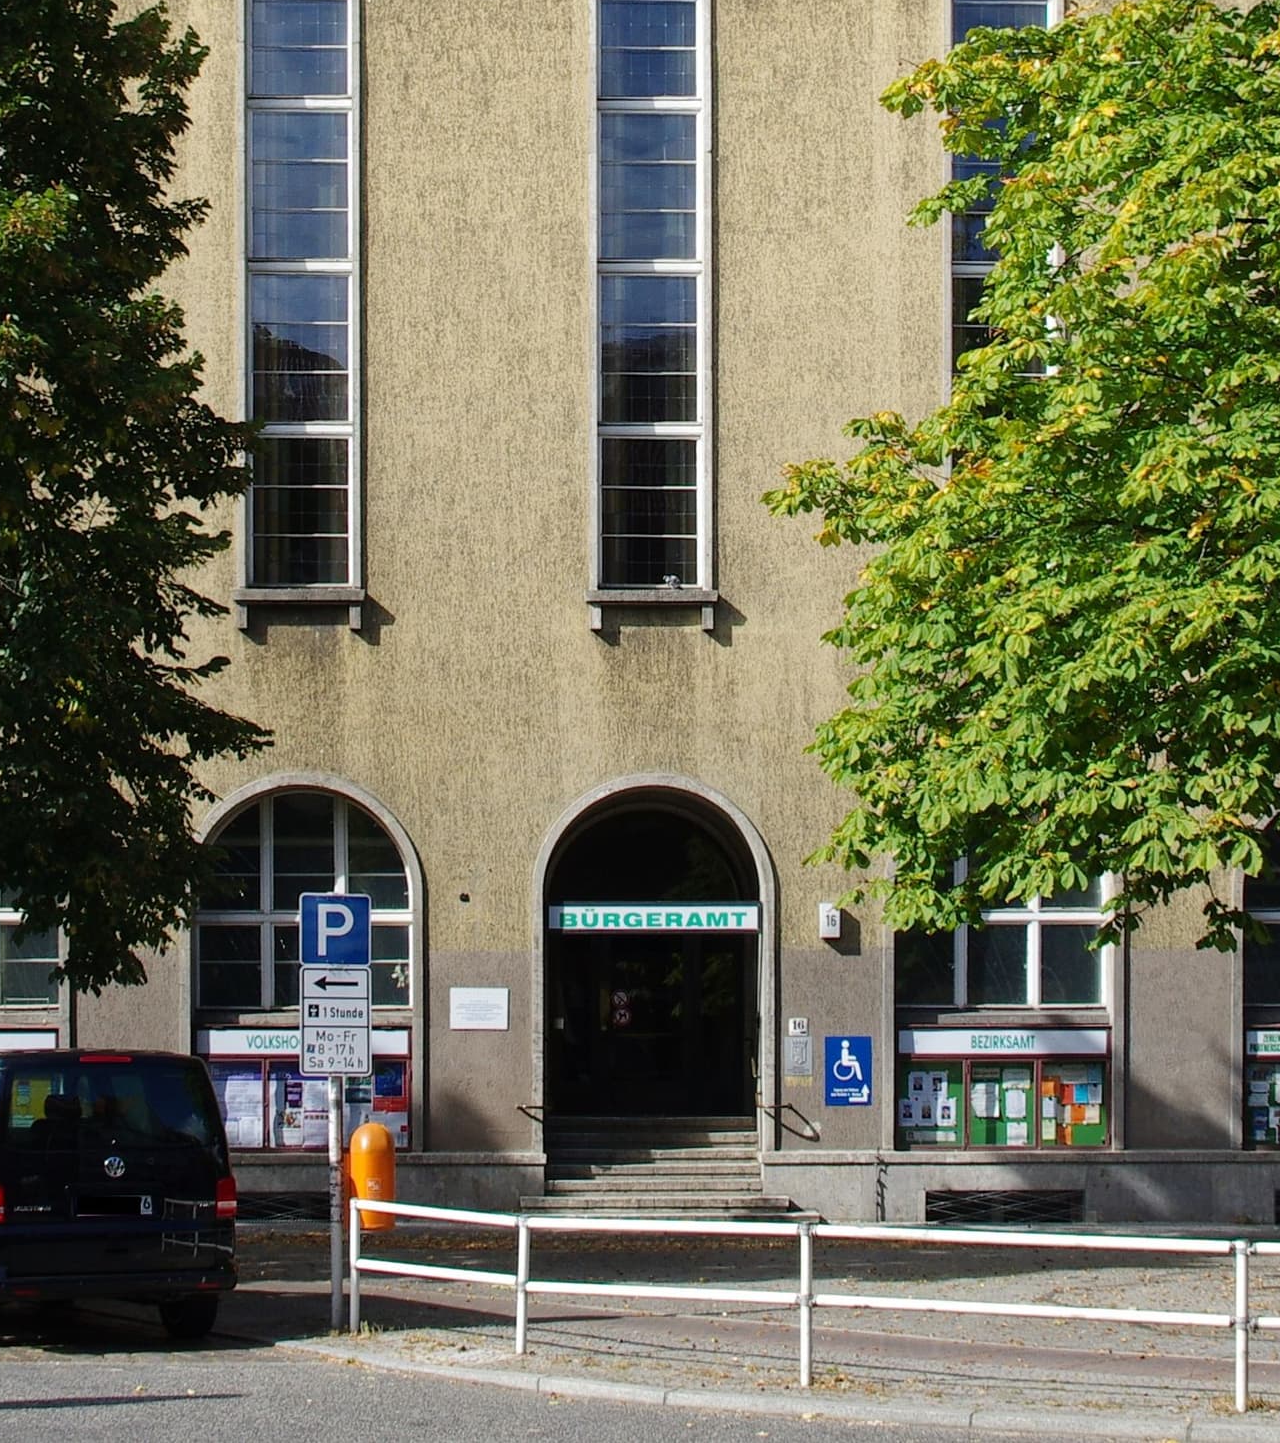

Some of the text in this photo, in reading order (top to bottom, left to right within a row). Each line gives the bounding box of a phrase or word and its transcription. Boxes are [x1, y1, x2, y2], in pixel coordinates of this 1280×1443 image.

[559, 908, 748, 928] BÜRGERAMT
[825, 914, 837, 927] 16
[317, 903, 354, 956] P
[322, 1006, 364, 1019] 1 Stunde
[792, 1019, 806, 1031] 16
[970, 1034, 1036, 1050] BEZIRKSAMT
[308, 1056, 324, 1069] Sa
